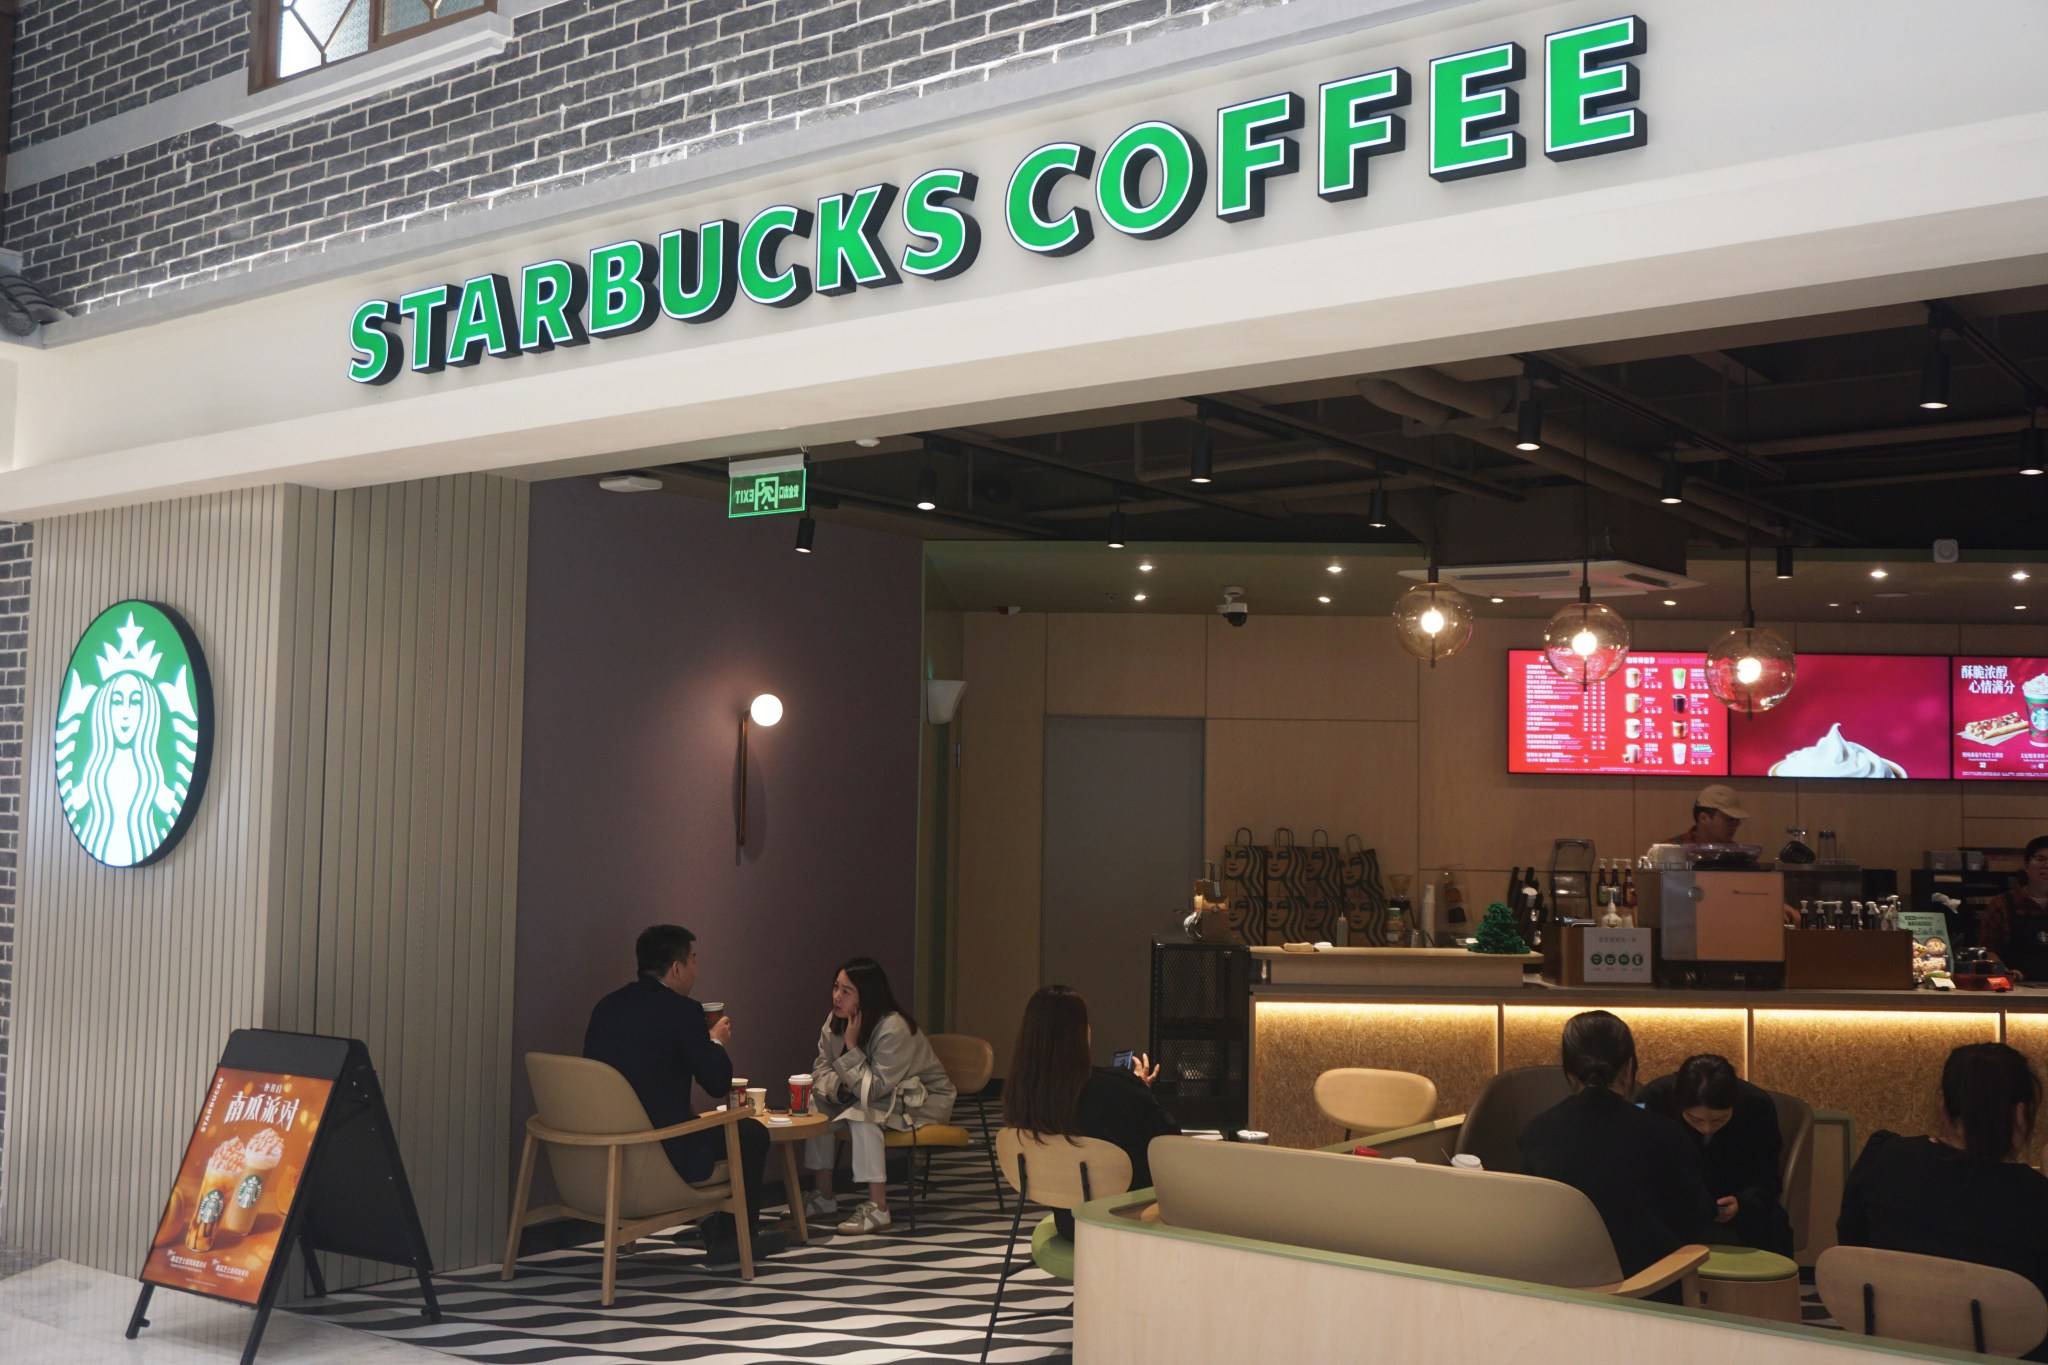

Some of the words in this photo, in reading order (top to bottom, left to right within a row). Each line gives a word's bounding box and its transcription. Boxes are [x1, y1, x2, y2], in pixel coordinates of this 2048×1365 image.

[348, 168, 980, 386] STARBUCKS
[1005, 14, 1648, 257] COFFEE
[1968, 680, 2015, 694] 心情满分
[224, 1091, 299, 1131] 南瓜派对
